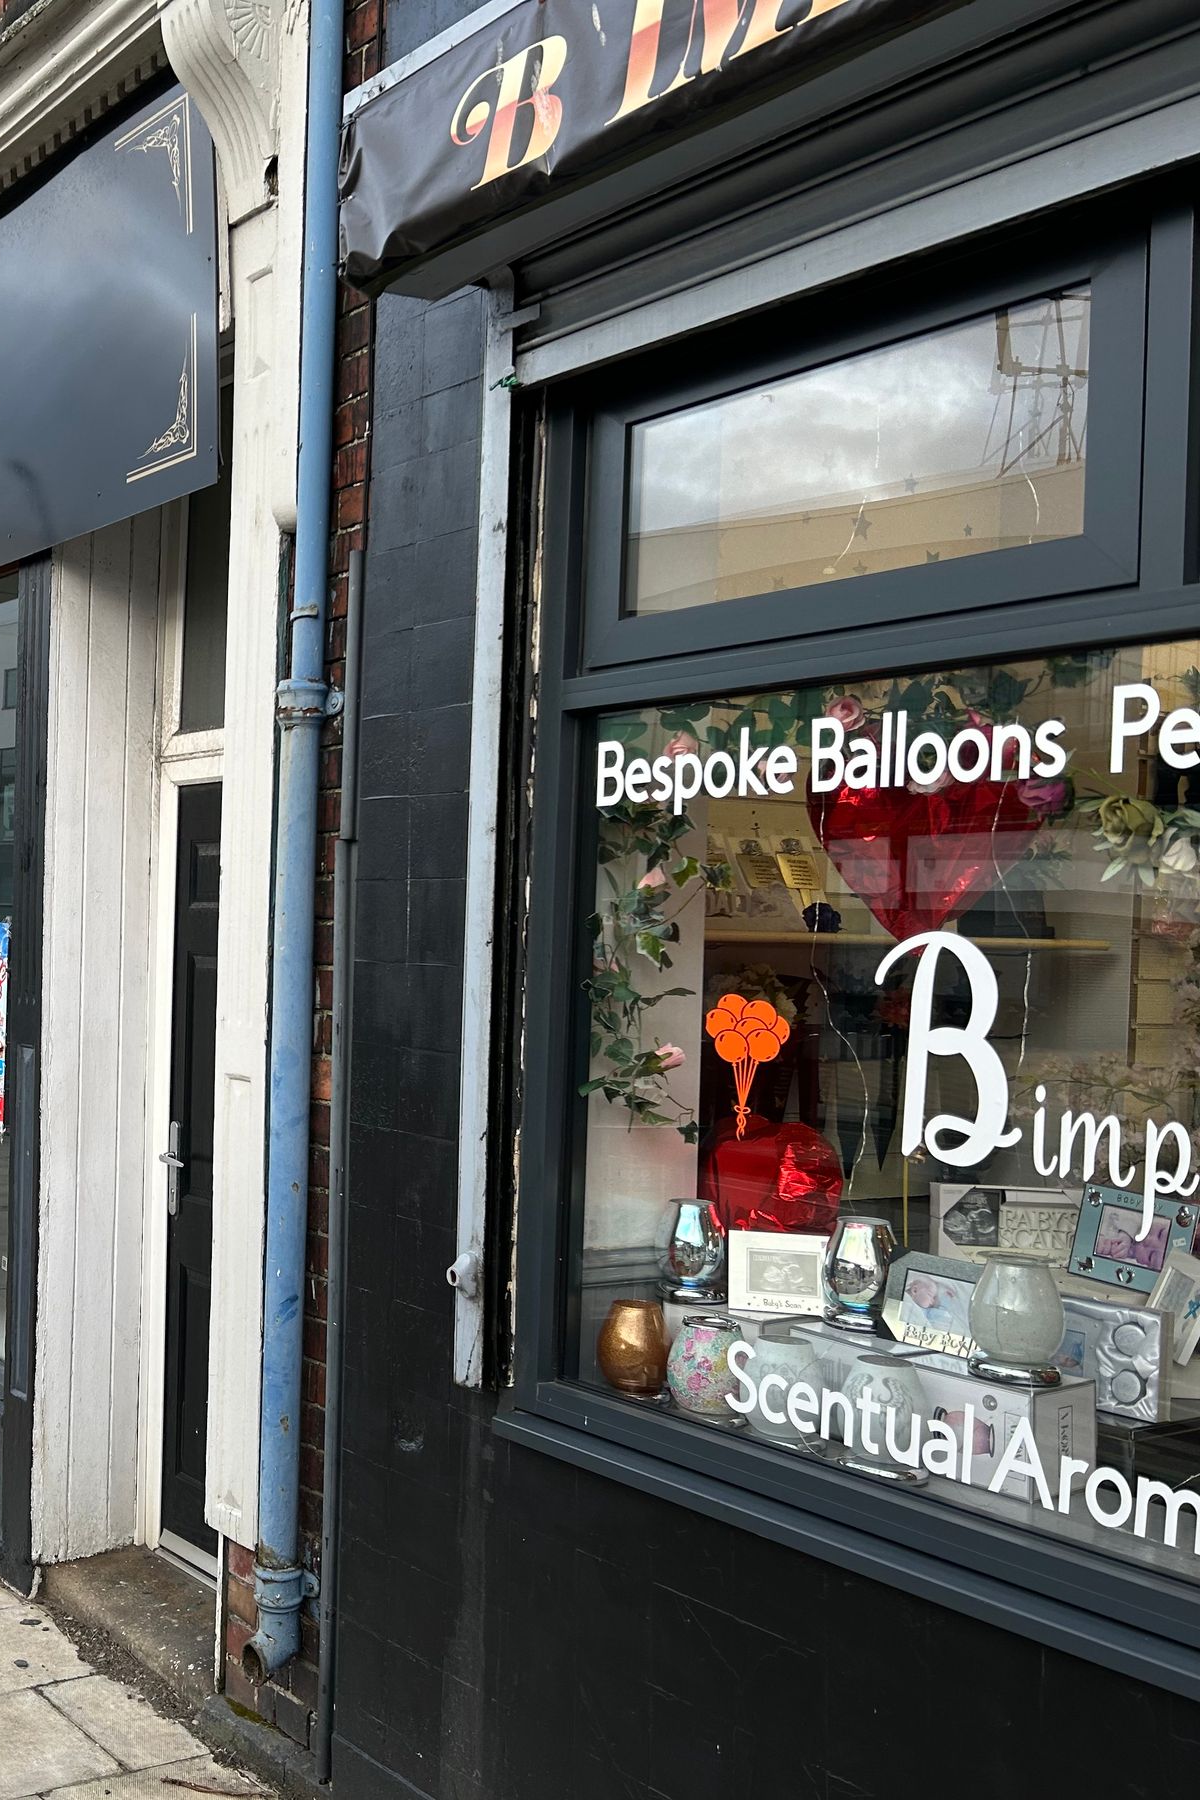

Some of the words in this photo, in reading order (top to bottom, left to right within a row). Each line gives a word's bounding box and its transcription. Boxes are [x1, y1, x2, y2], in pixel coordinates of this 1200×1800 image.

[595, 726, 798, 816] Bespoke
[810, 710, 1068, 795] Balloons
[998, 1229, 1075, 1251] SCAN
[904, 1323, 938, 1346] Baby
[723, 1339, 975, 1485] Scentual
